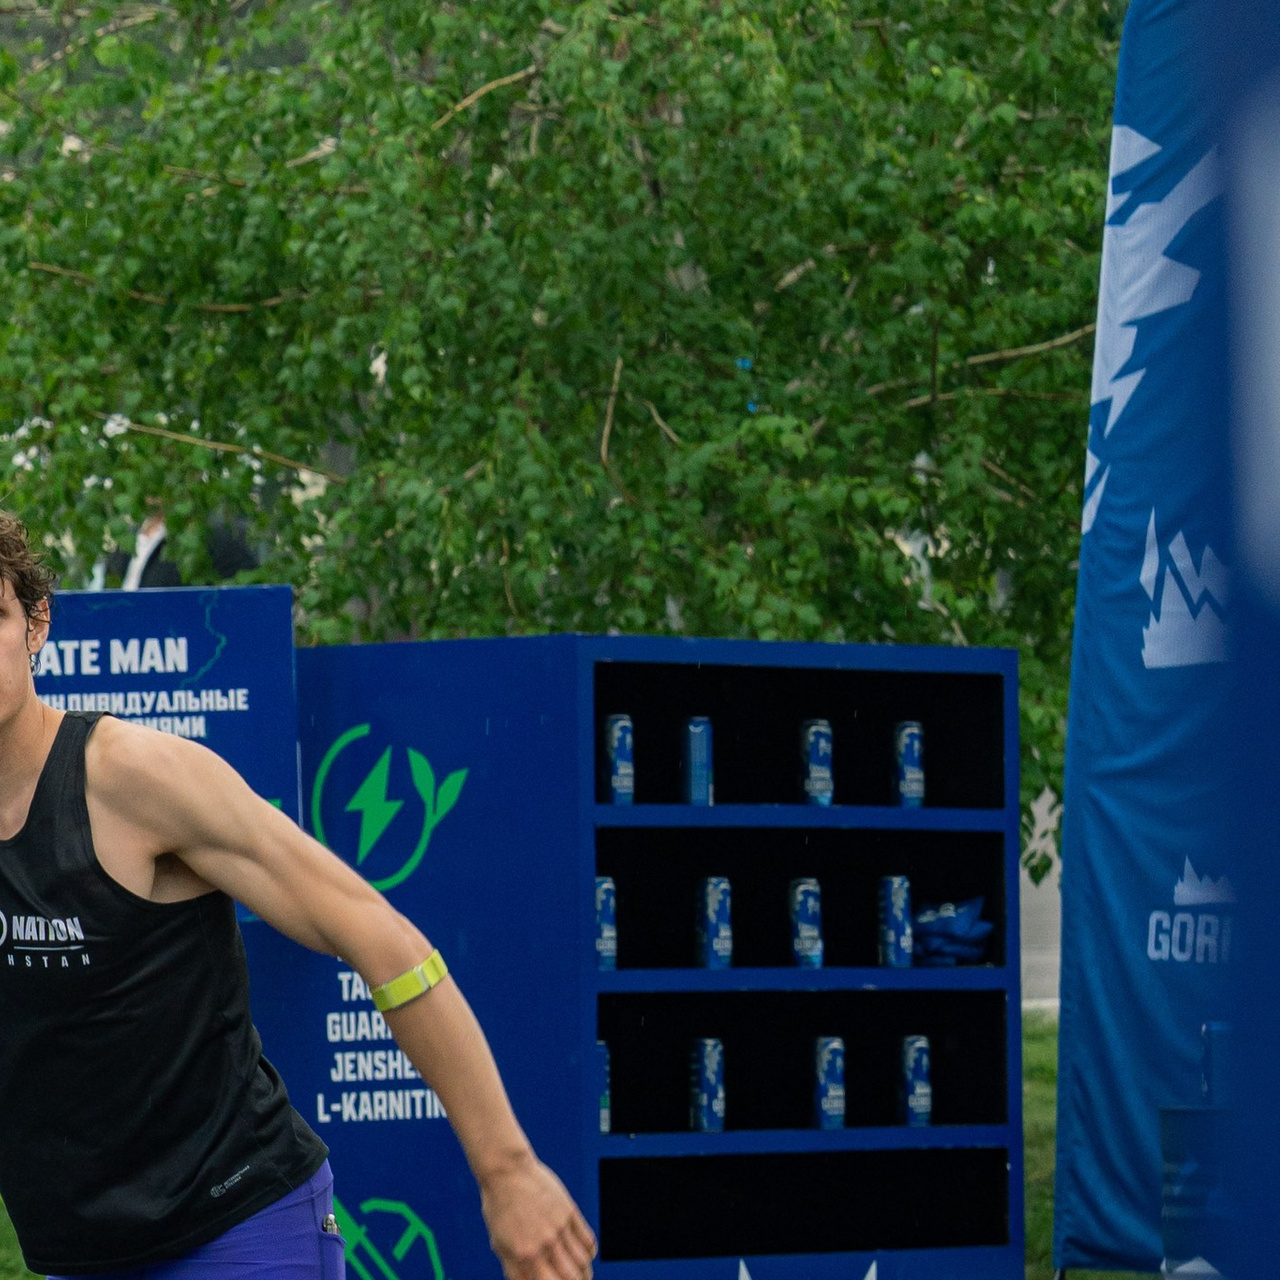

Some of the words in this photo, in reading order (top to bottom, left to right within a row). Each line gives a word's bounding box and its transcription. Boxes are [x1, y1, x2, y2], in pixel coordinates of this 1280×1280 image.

[30, 639, 101, 676] ATE
[110, 637, 188, 674] MAN
[12, 915, 85, 941] NATION
[337, 972, 373, 1001] TA
[326, 1010, 392, 1042] GUAR
[331, 1050, 422, 1083] JENSHE
